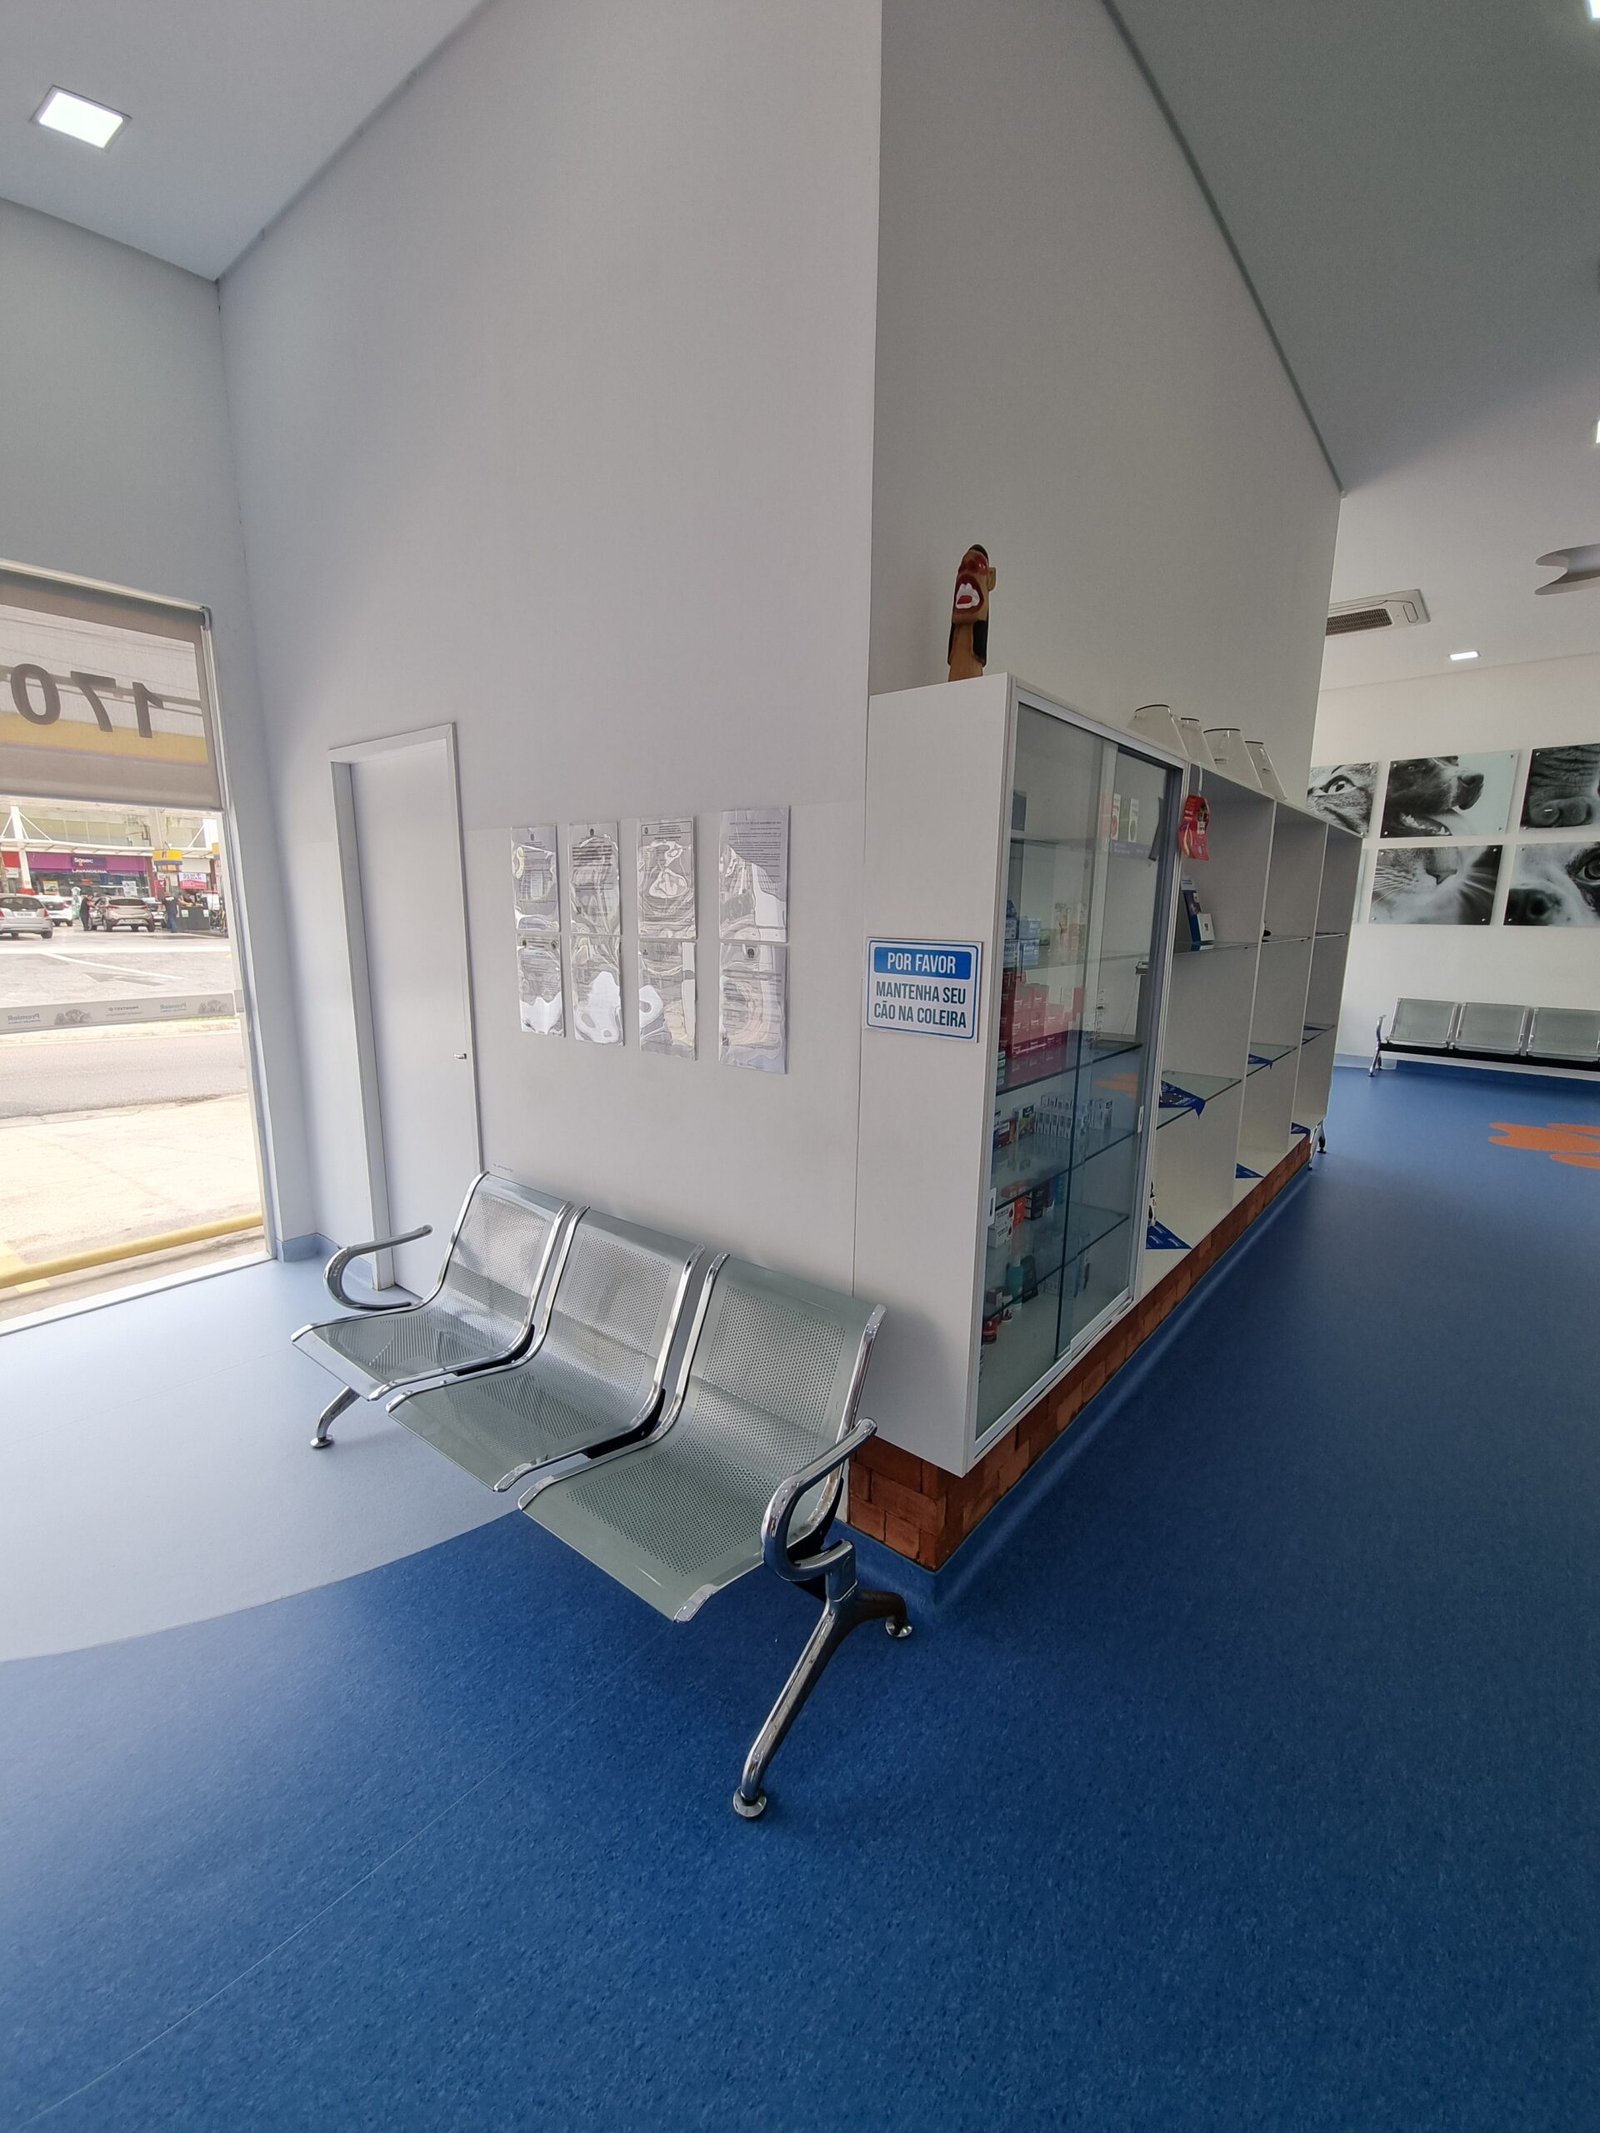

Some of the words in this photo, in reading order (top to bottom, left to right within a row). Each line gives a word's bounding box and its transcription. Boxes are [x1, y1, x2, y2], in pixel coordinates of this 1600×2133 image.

[887, 952, 912, 971] POR
[915, 953, 956, 974] FAVOR
[876, 981, 940, 1002] MANTENHA
[942, 986, 966, 1004] SEU
[874, 1000, 896, 1020] CÃO
[898, 1005, 914, 1022] NA
[917, 1007, 967, 1028] COLEIRA
